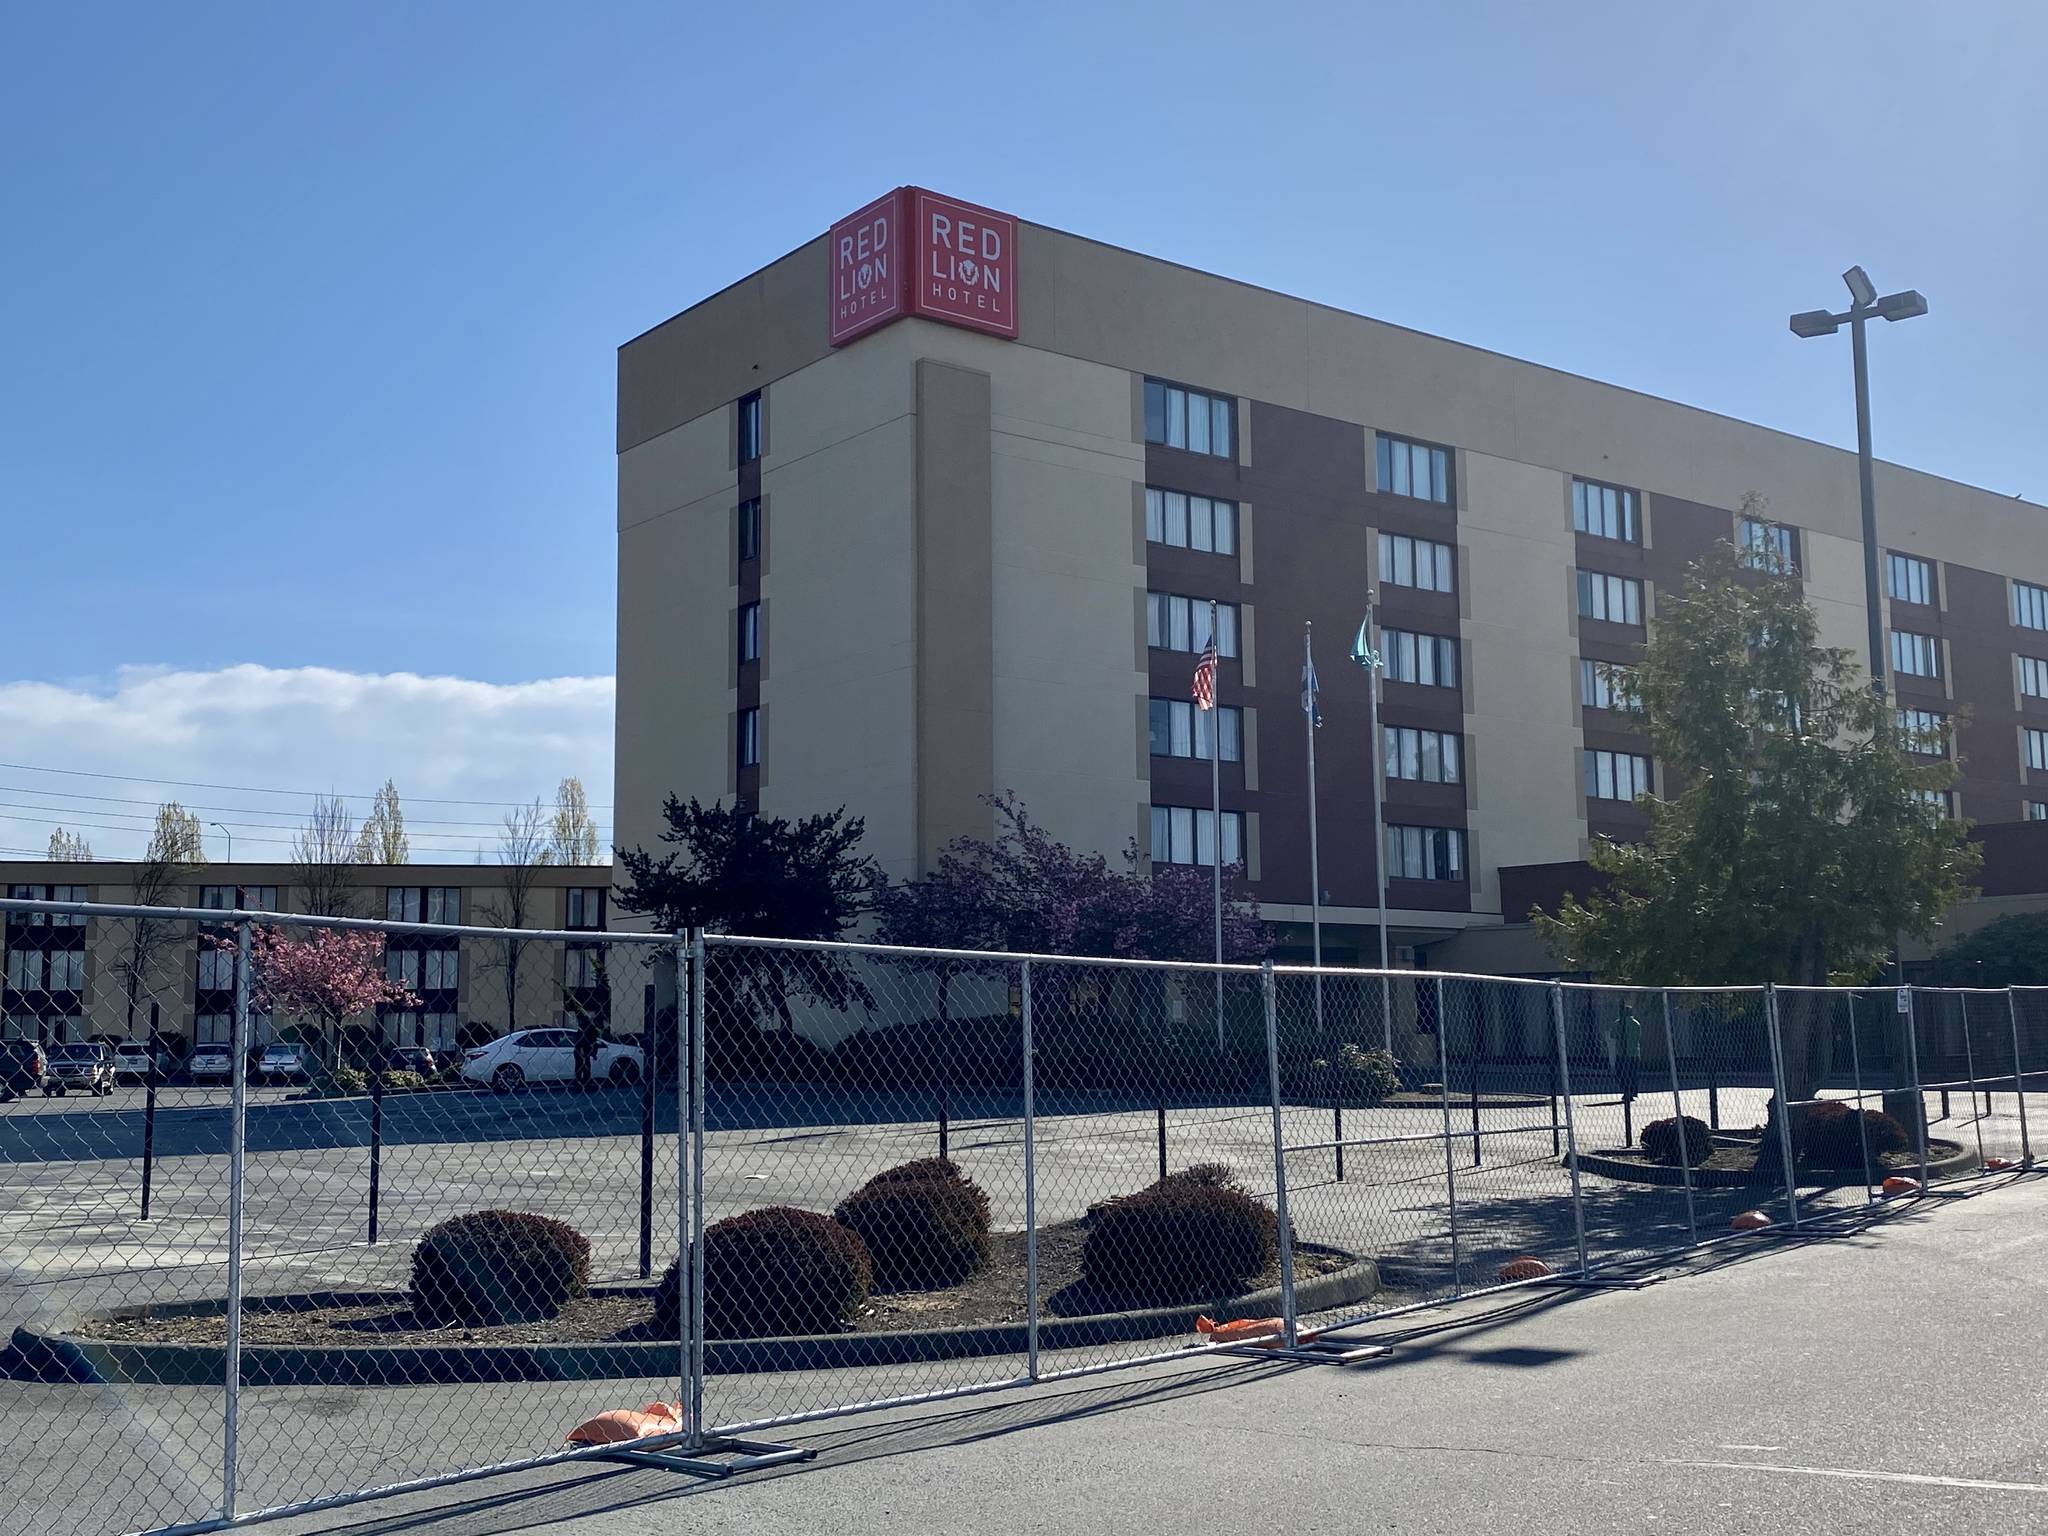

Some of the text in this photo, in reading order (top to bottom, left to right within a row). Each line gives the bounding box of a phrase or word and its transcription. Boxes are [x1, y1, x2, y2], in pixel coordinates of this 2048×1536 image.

[840, 217, 888, 269] RED
[932, 213, 1000, 261] RED
[840, 253, 887, 300] LION
[932, 250, 1000, 293] LION
[840, 287, 887, 320] HOTEL
[932, 283, 1000, 313] HOTEL
